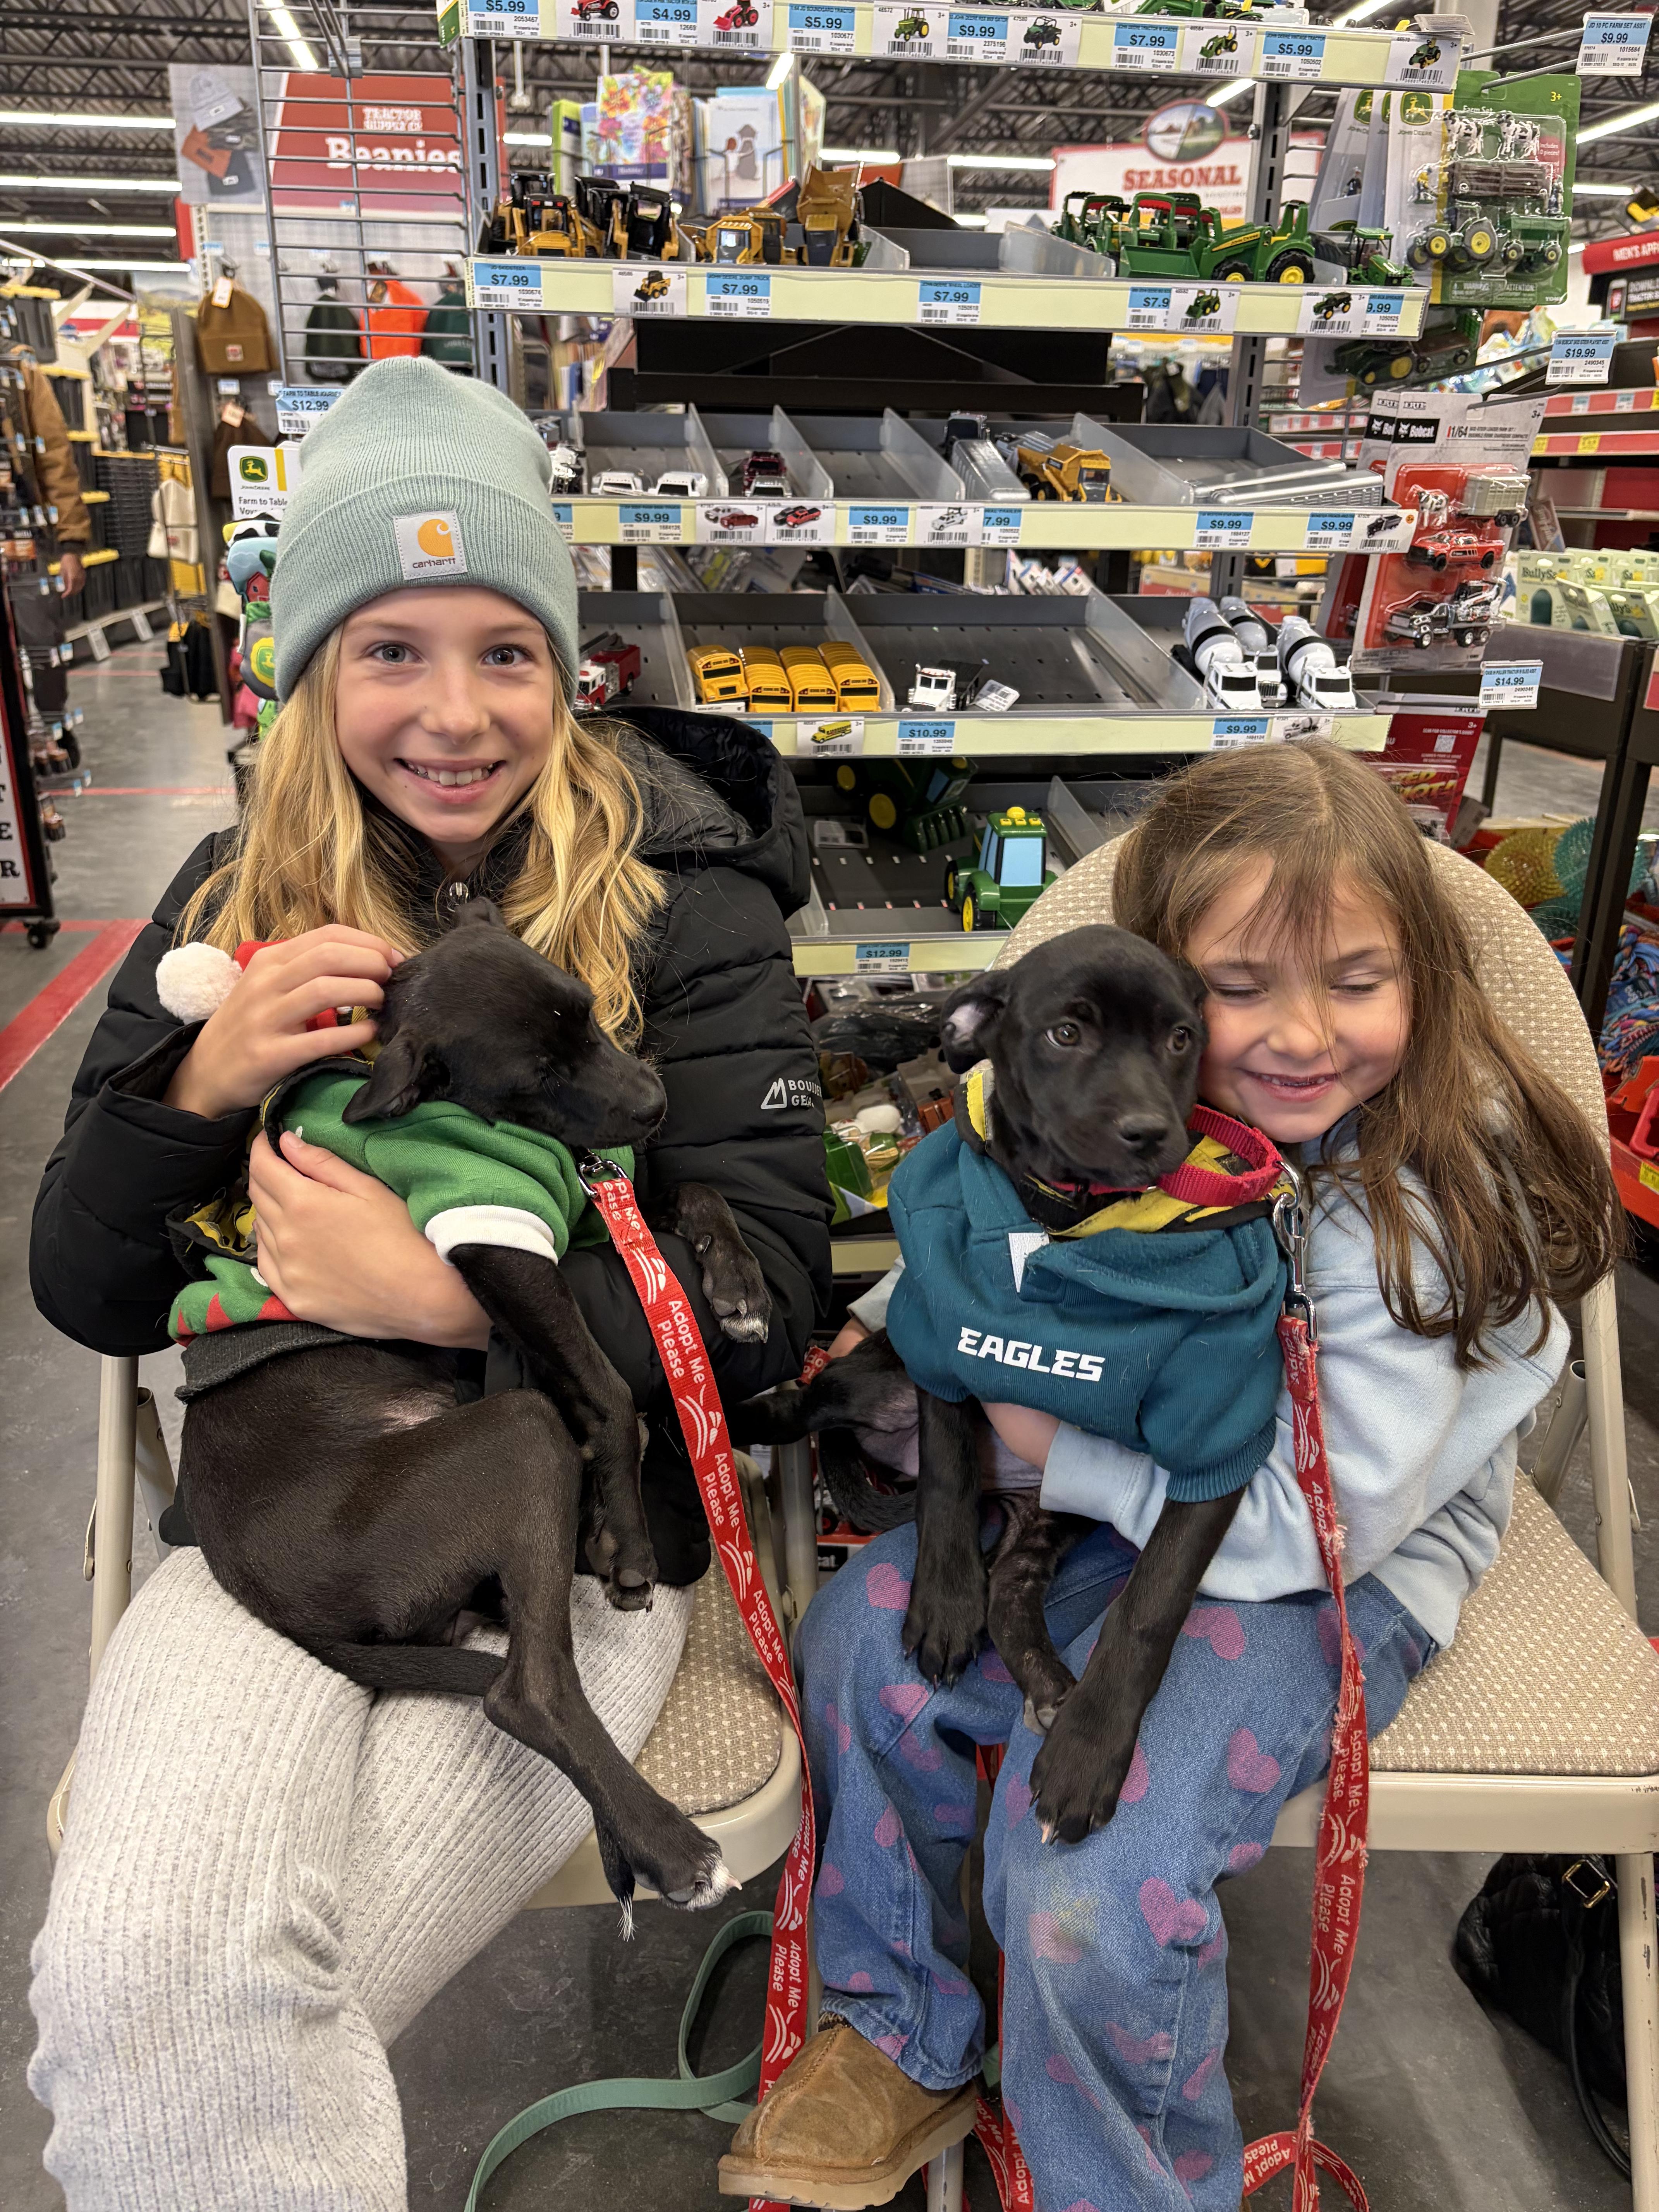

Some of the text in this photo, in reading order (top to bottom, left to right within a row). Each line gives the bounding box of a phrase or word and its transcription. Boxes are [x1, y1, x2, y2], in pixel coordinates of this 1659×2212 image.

[486, 0, 525, 12] $5.99
[652, 8, 691, 21] $4.99
[805, 16, 842, 29] $5.99
[959, 25, 995, 37] $9.99
[1130, 34, 1165, 46] $7.99
[1601, 33, 1628, 44] $9.99
[1278, 43, 1312, 55] $5.99
[1550, 91, 1563, 102] 3+
[362, 107, 422, 120] TRACTOR
[325, 137, 460, 173] Beanies
[1123, 164, 1242, 191] SEASONAL
[491, 274, 529, 286] $7.99
[722, 283, 758, 295] $7.99
[934, 291, 969, 302] $7.99
[1143, 297, 1169, 308] $7.9
[1565, 349, 1596, 358] $19.99
[292, 400, 329, 410] $12.99
[1531, 410, 1541, 418] 3+
[1409, 424, 1435, 438] Bobcat
[1451, 426, 1468, 438] 1/64
[634, 513, 670, 522] $9.99
[863, 515, 897, 525] $9.99
[1210, 520, 1242, 529] $9.99
[1321, 521, 1353, 531] $9.99
[412, 558, 456, 568] carhartt
[1495, 677, 1524, 686] $14.99
[908, 729, 946, 737] $10.99
[1226, 725, 1257, 733] $9.99
[866, 950, 902, 958] $12.99
[622, 1206, 641, 1231] Me
[668, 1300, 706, 1385] Adopt Me
[657, 1319, 685, 1379] Please
[957, 1326, 1106, 1382] EAGLES
[714, 1452, 741, 1529] Adopt Me
[702, 1470, 725, 1527] Please
[752, 1589, 785, 1664] Adopt Me
[748, 1609, 773, 1665] Please
[1333, 1747, 1350, 1803] Please
[1348, 1729, 1363, 1810] Adopt Me
[798, 1855, 809, 1881] Me
[1319, 1883, 1335, 1934] Please
[1333, 1873, 1356, 1956] Adopt Me
[772, 1941, 787, 1992] Please
[787, 1938, 802, 2009] Adopt Me
[1244, 2140, 1279, 2164] Pleas
[1243, 2148, 1291, 2187] Adopt M
